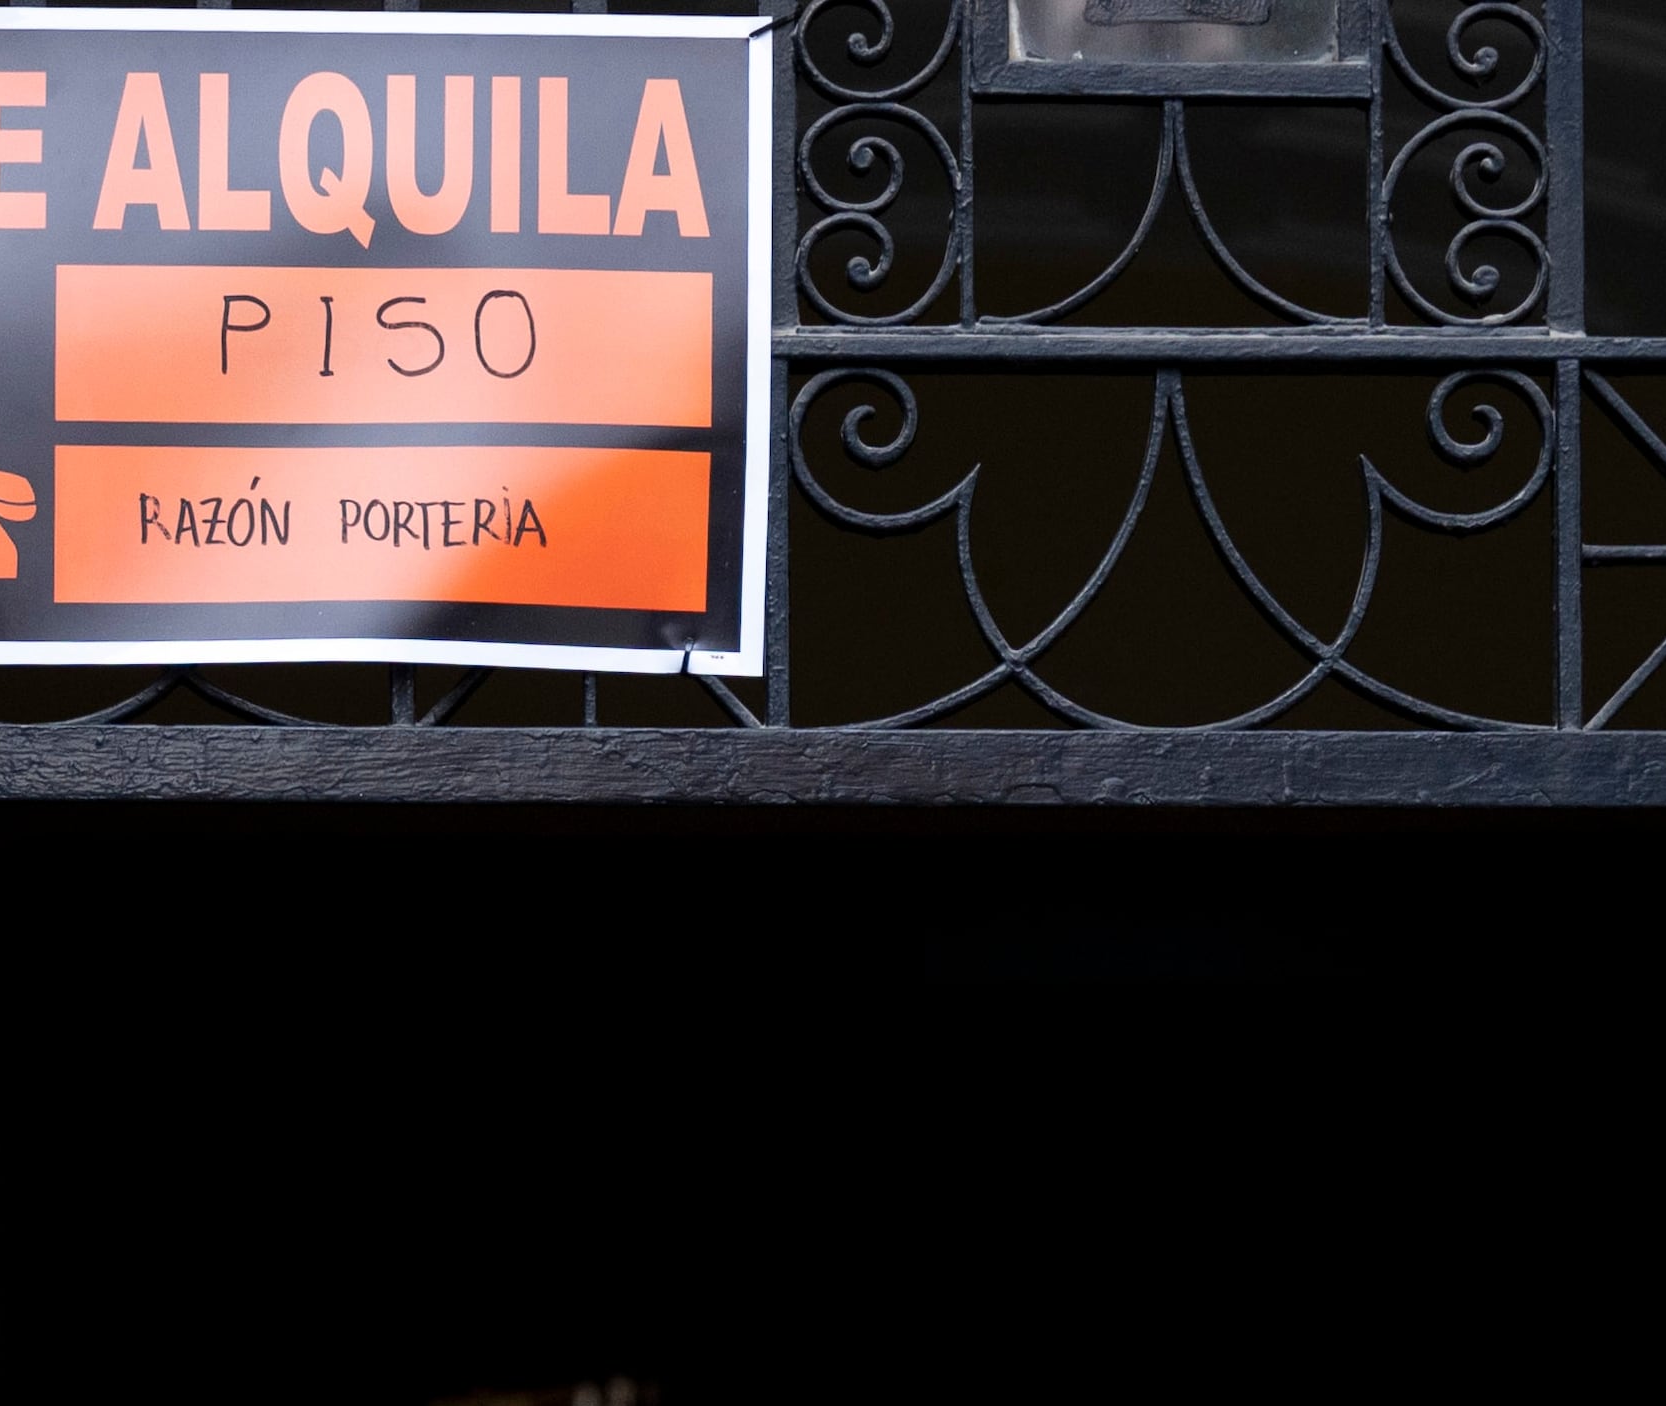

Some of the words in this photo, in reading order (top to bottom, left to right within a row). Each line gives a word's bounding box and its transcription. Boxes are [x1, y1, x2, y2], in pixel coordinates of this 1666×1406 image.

[93, 72, 711, 249] ALQUILA
[220, 289, 537, 378] PISO
[139, 476, 291, 547] RAZÓN
